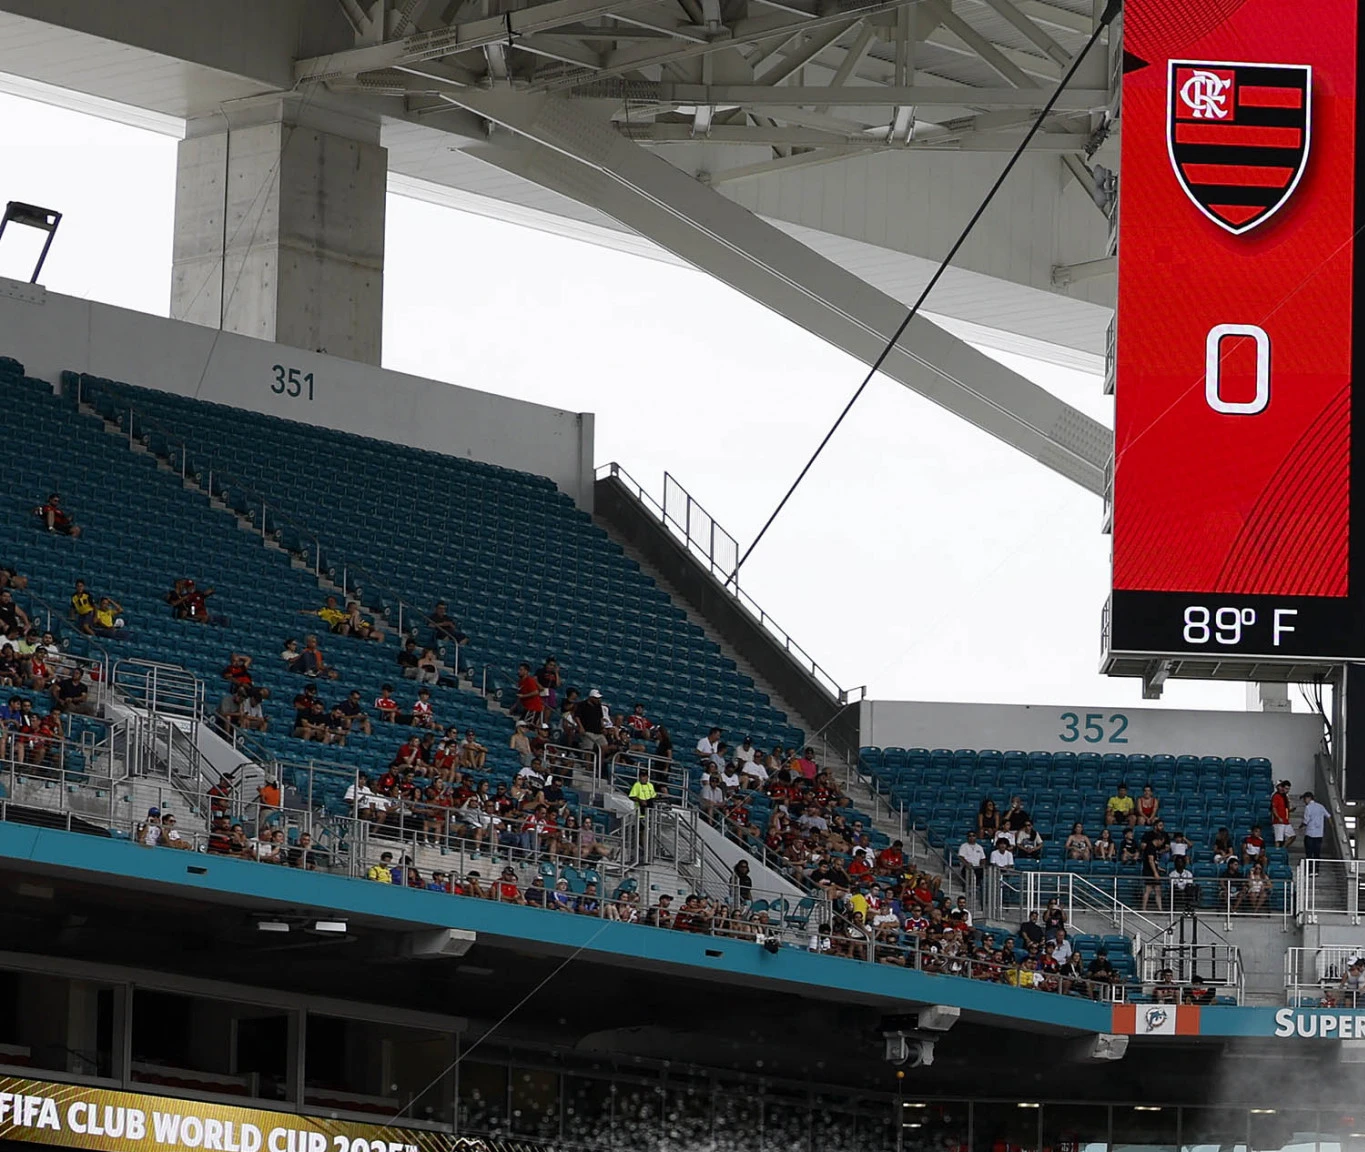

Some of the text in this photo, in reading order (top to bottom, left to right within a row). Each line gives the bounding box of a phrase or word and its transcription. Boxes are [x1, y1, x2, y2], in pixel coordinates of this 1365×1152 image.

[271, 365, 315, 400] 351
[1206, 324, 1269, 413] 0
[1274, 610, 1297, 645] F
[1059, 714, 1128, 744] 352
[68, 1102, 145, 1139] CLUB
